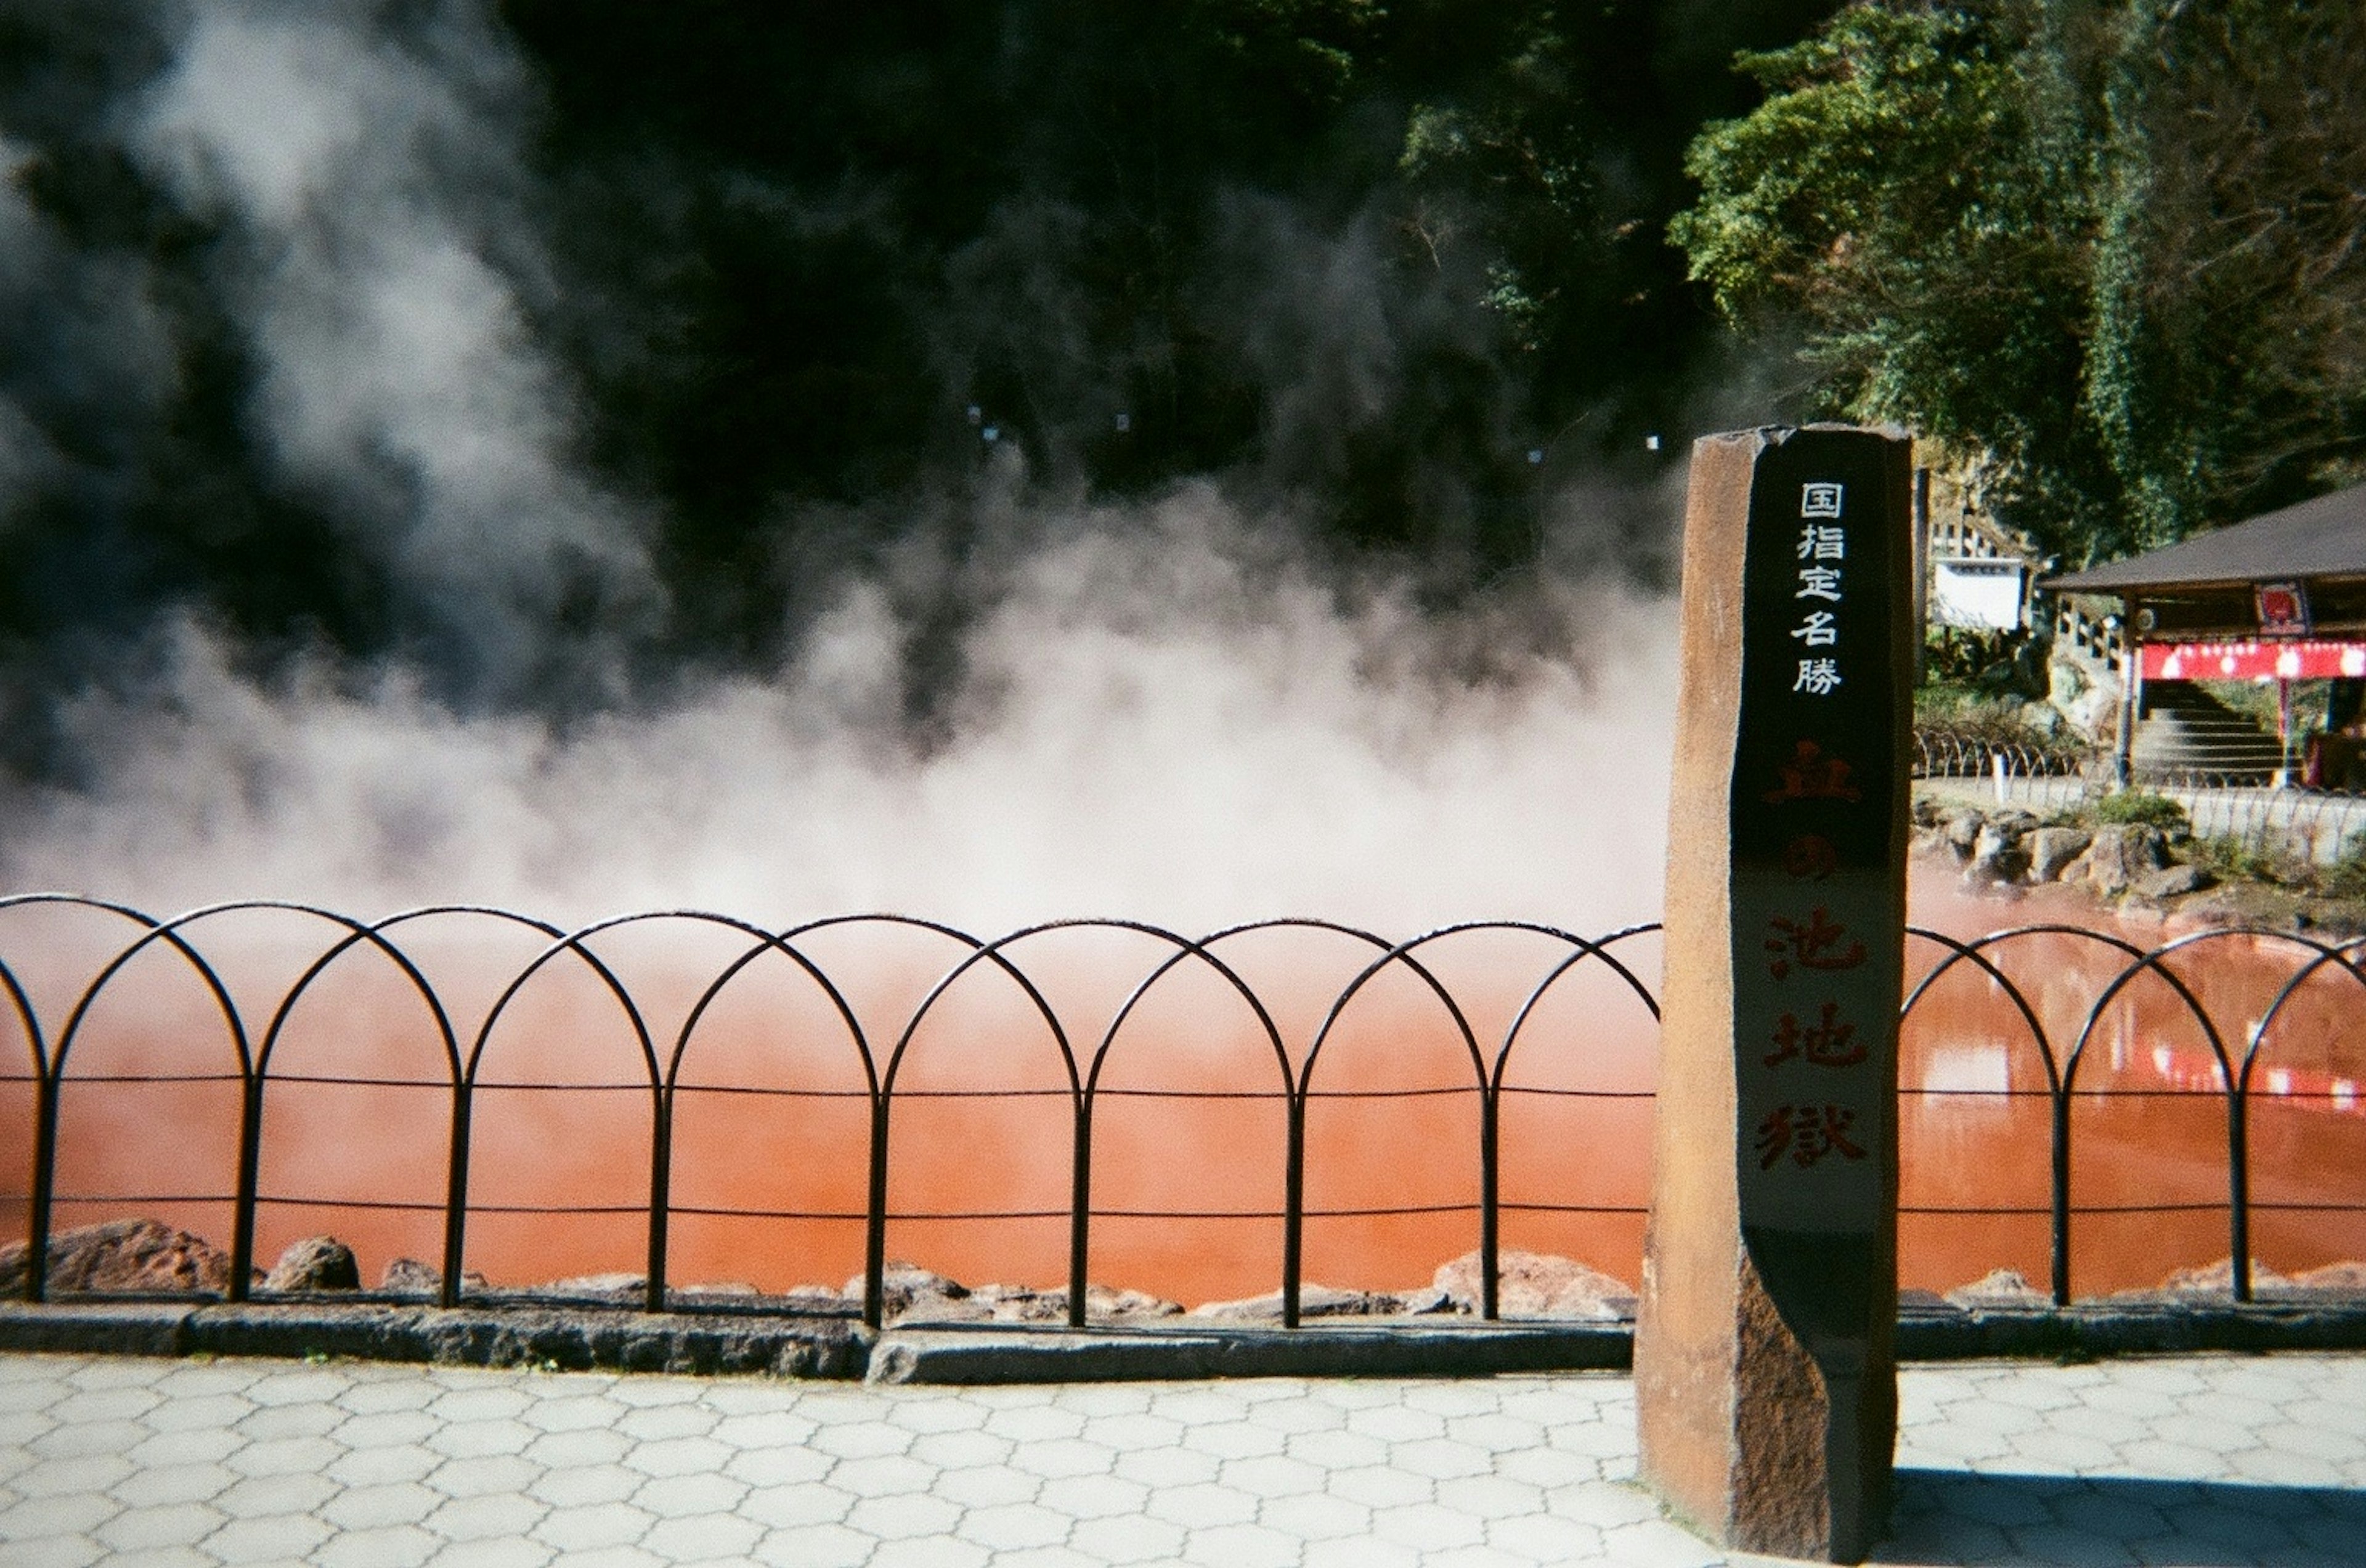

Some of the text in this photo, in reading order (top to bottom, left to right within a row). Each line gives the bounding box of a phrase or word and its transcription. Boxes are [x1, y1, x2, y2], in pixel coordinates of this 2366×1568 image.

[1757, 482, 1867, 1170] 国指定名勝 血の池地獄
